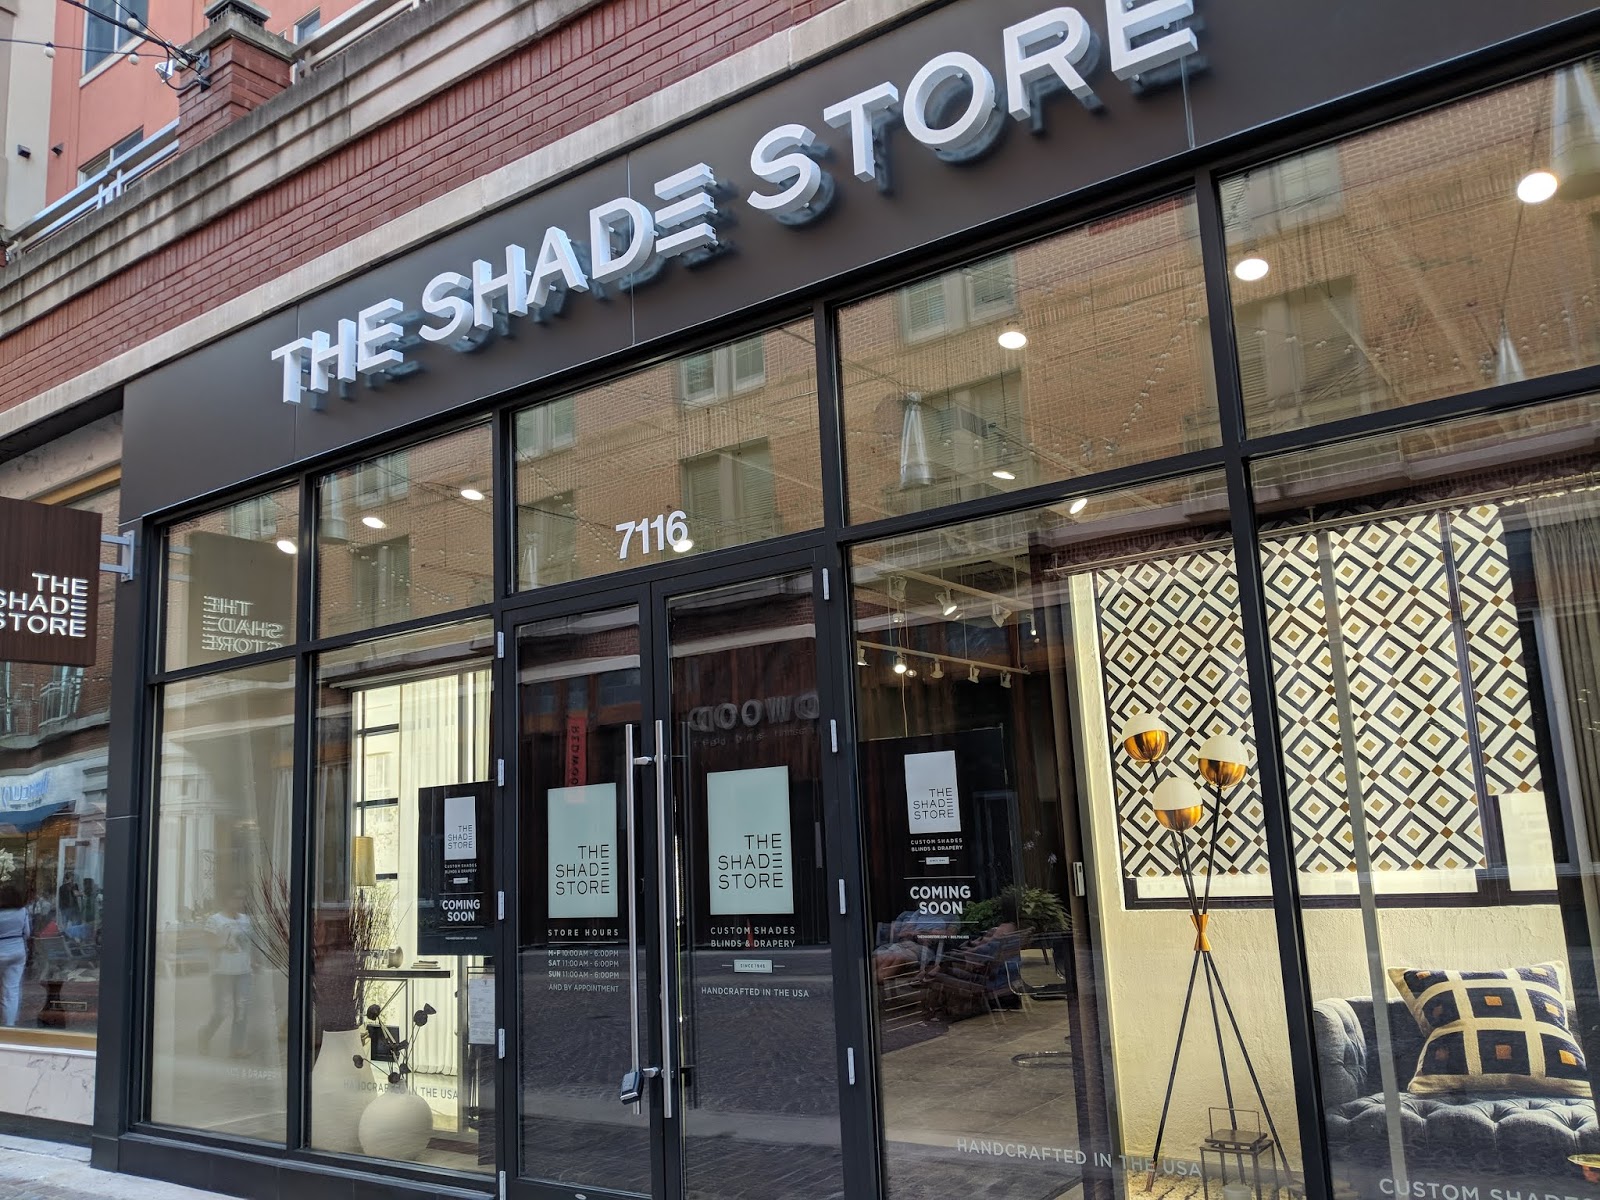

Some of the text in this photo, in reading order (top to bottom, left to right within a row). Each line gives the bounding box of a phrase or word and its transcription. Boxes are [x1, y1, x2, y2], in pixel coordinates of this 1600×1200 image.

[271, 0, 1198, 406] THE SHADE STORE
[615, 510, 689, 560] 7116
[32, 572, 89, 596] THE
[928, 787, 953, 798] THE
[912, 798, 953, 810] SHADE
[913, 808, 955, 820] STORE
[457, 824, 473, 832] THE
[447, 832, 473, 842] SHADE
[744, 833, 782, 850] THE
[447, 841, 473, 850] STORE
[577, 844, 610, 860] THE
[718, 852, 783, 871] SHADE
[555, 862, 610, 878] SHADE
[718, 872, 784, 890] STORE
[555, 879, 610, 896] STORE
[910, 885, 971, 899] COMING
[442, 899, 480, 910] COMING
[919, 901, 963, 915] SOON
[447, 911, 475, 921] SOON
[548, 928, 619, 937] STORE HOURS
[710, 926, 796, 935] CUSTOM SHADES
[710, 939, 796, 948] BLINDS & DRAPERY
[548, 959, 561, 967] SAT
[548, 970, 561, 978] SUN
[548, 983, 563, 991] AND
[573, 984, 620, 993] APPOINTMENT
[701, 986, 810, 998] HANDCRAFTED IN THE USA
[420, 1087, 438, 1098] THE
[440, 1088, 458, 1100] USA
[957, 1137, 1202, 1177] HANDCRAFTED IN THE USA
[1379, 1178, 1593, 1200] CUSTOM SHA
